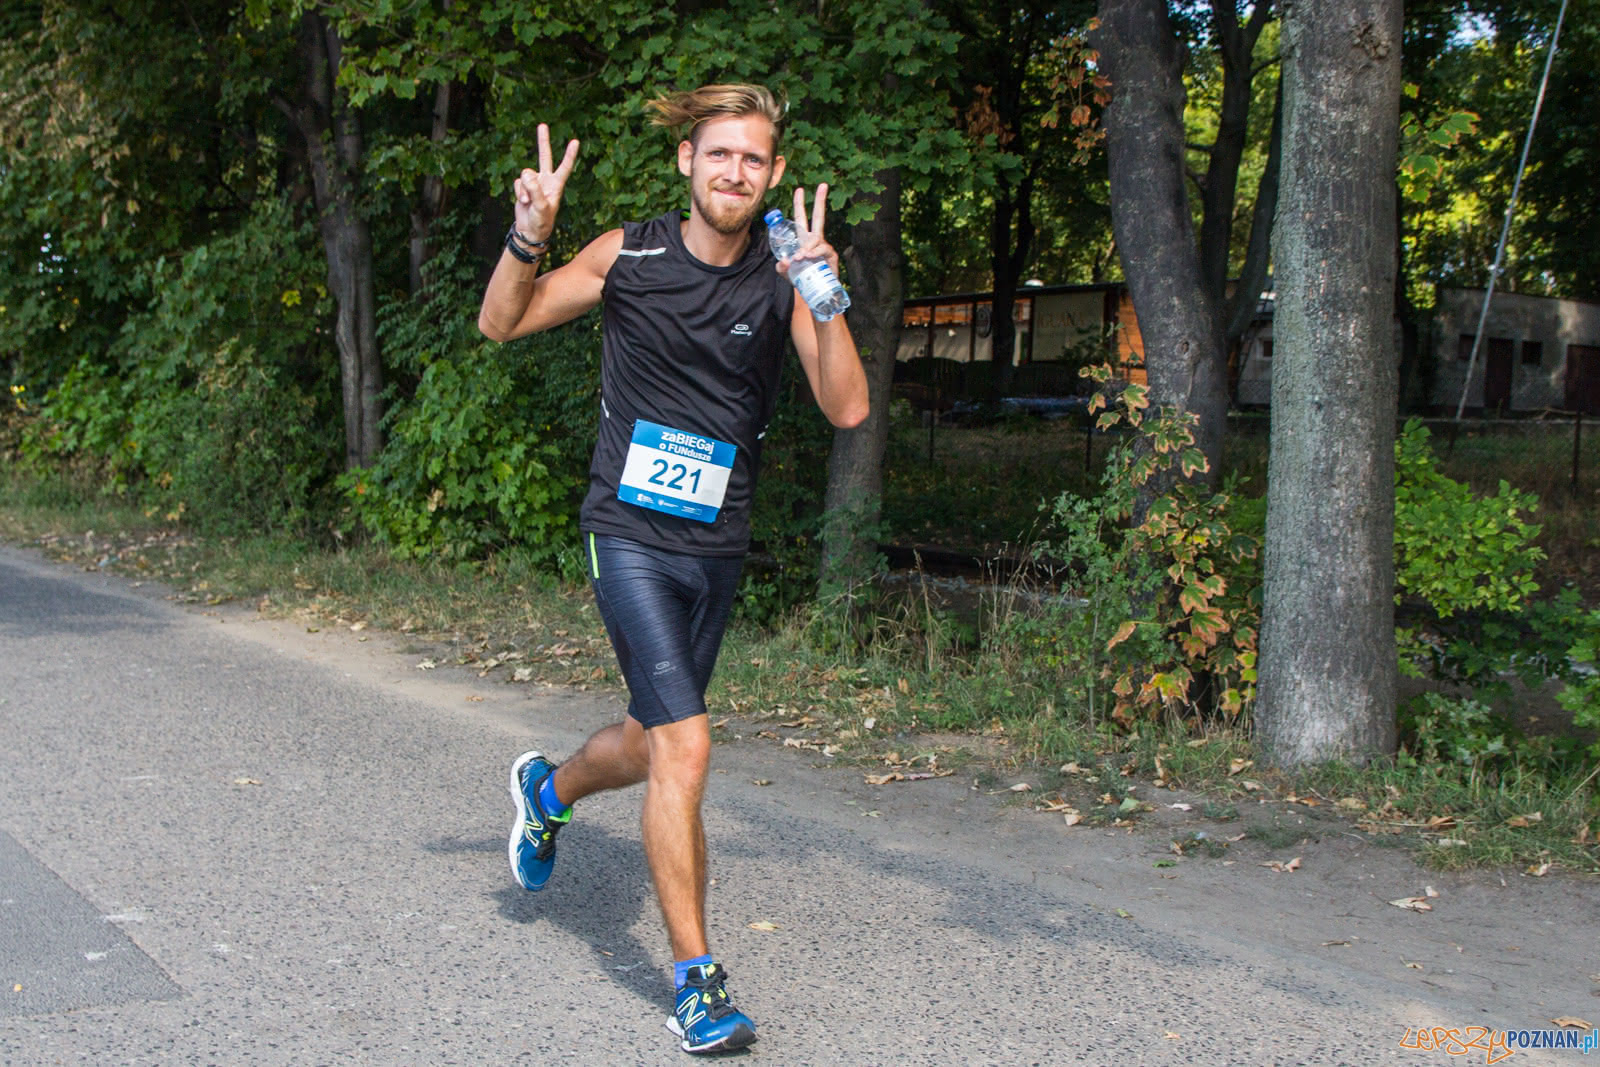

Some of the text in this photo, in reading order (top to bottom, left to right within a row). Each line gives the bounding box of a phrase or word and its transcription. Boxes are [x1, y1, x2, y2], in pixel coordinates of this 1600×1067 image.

[658, 442, 712, 462] o FUNdusze
[661, 431, 715, 455] zaBIEGaj
[647, 458, 702, 494] 221
